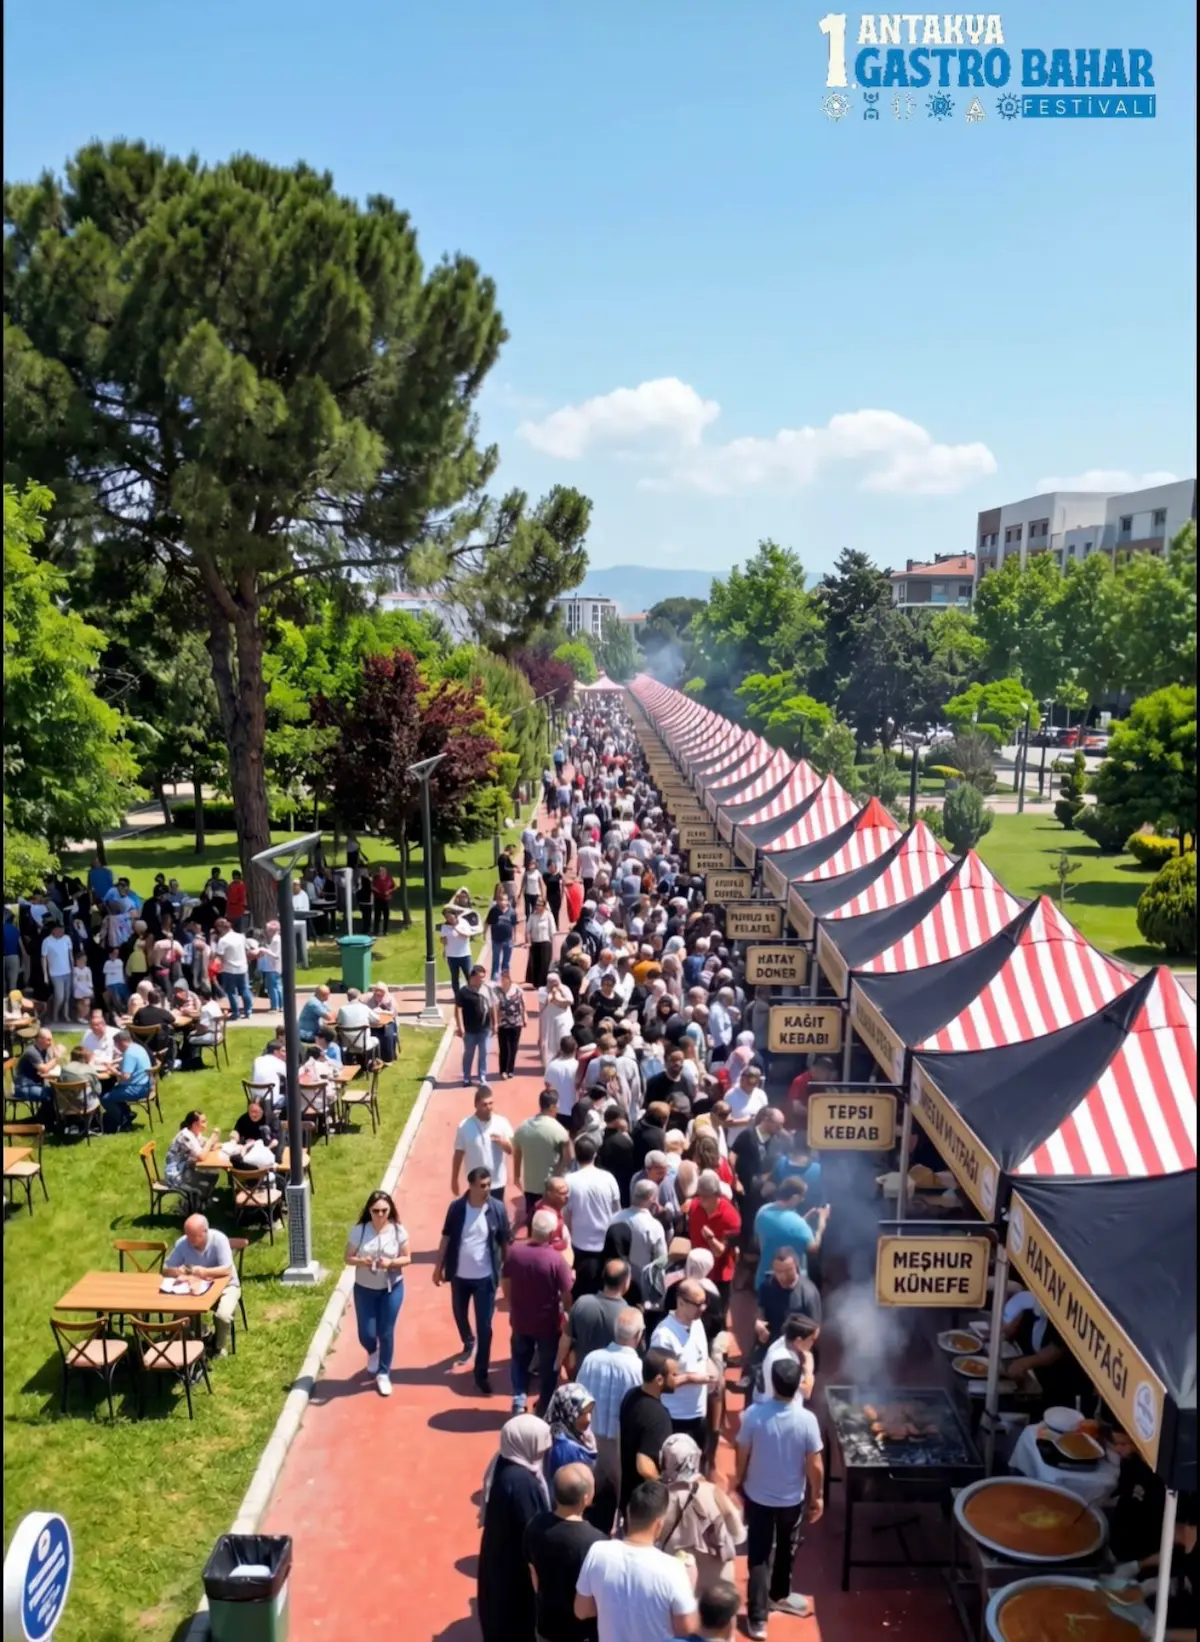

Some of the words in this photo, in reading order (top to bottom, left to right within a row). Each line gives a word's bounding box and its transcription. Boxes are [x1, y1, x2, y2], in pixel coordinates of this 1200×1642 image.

[757, 954, 795, 964] HATAY
[824, 1126, 879, 1140] KEBAB
[893, 1252, 973, 1272] MEŞHUR
[894, 1275, 969, 1293] KÜNEFE
[1026, 1236, 1066, 1307] HATAY
[1065, 1292, 1129, 1398] MUTFAĞI
